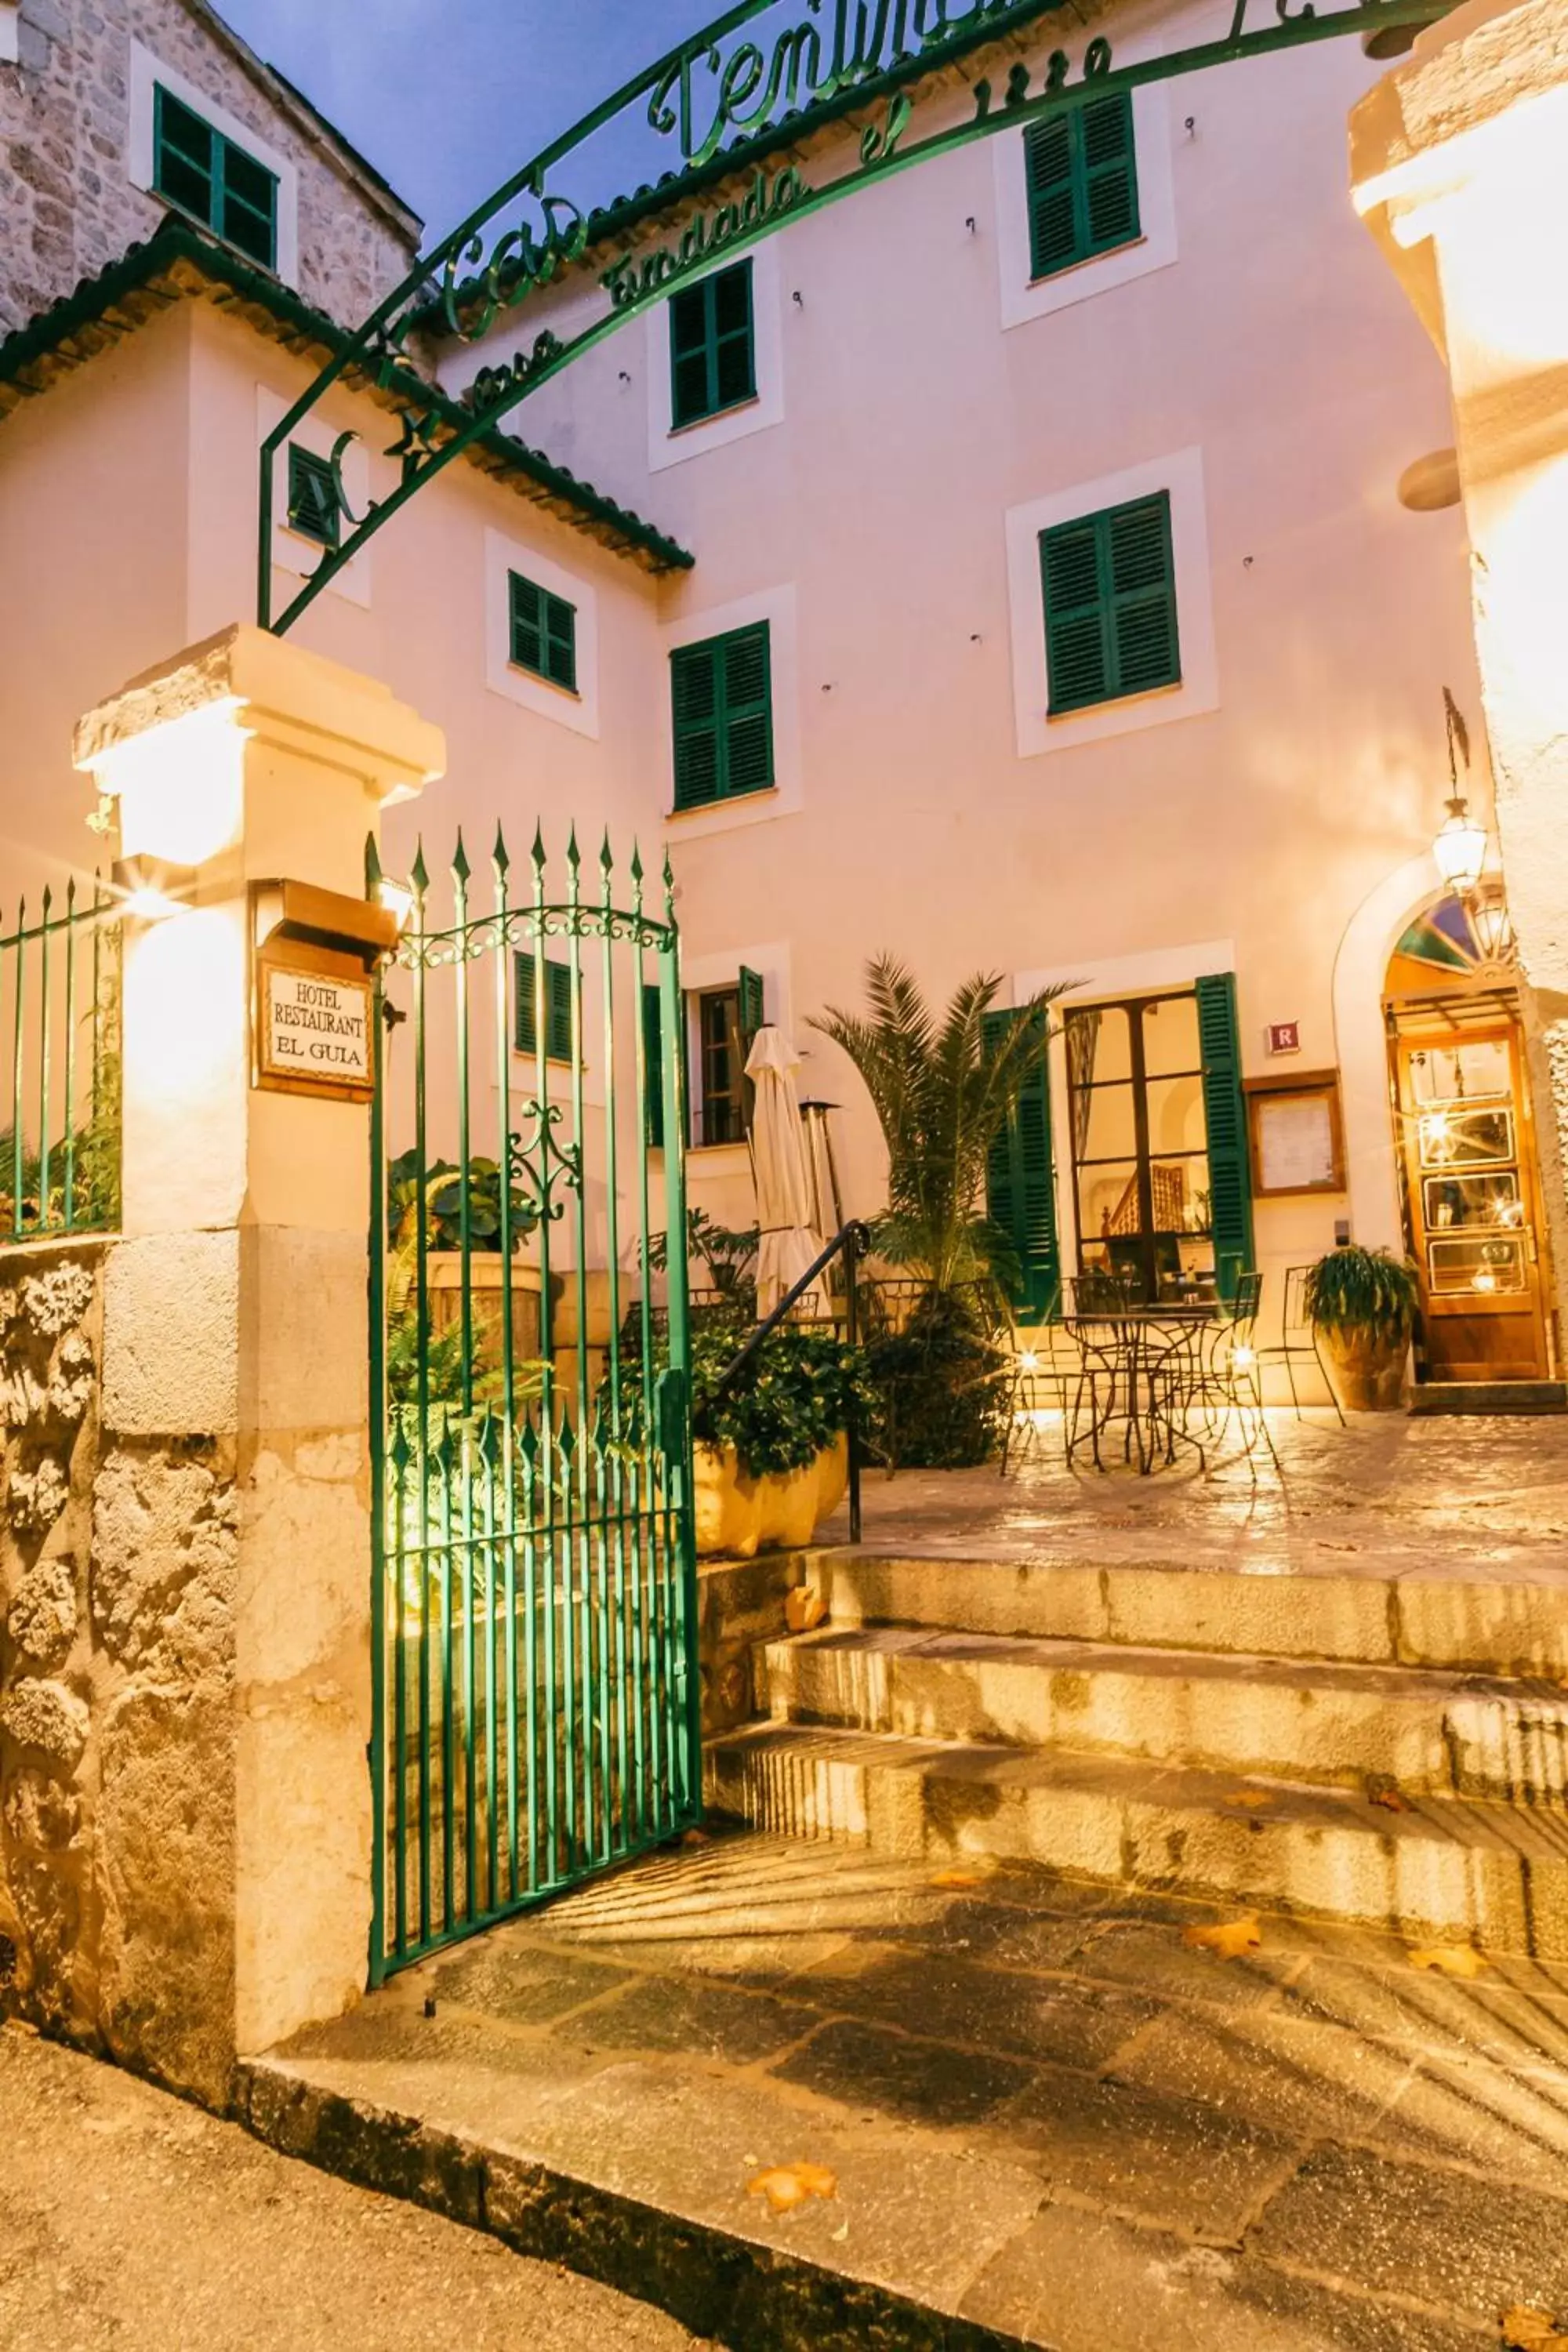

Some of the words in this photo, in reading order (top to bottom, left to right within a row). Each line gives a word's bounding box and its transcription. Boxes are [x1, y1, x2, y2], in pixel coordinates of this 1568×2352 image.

[296, 982, 342, 1011] HOTEL
[274, 1003, 363, 1039] RESTAURANT
[276, 1036, 305, 1057] EL
[310, 1044, 362, 1066] GUIA
[1278, 1028, 1292, 1046] R
